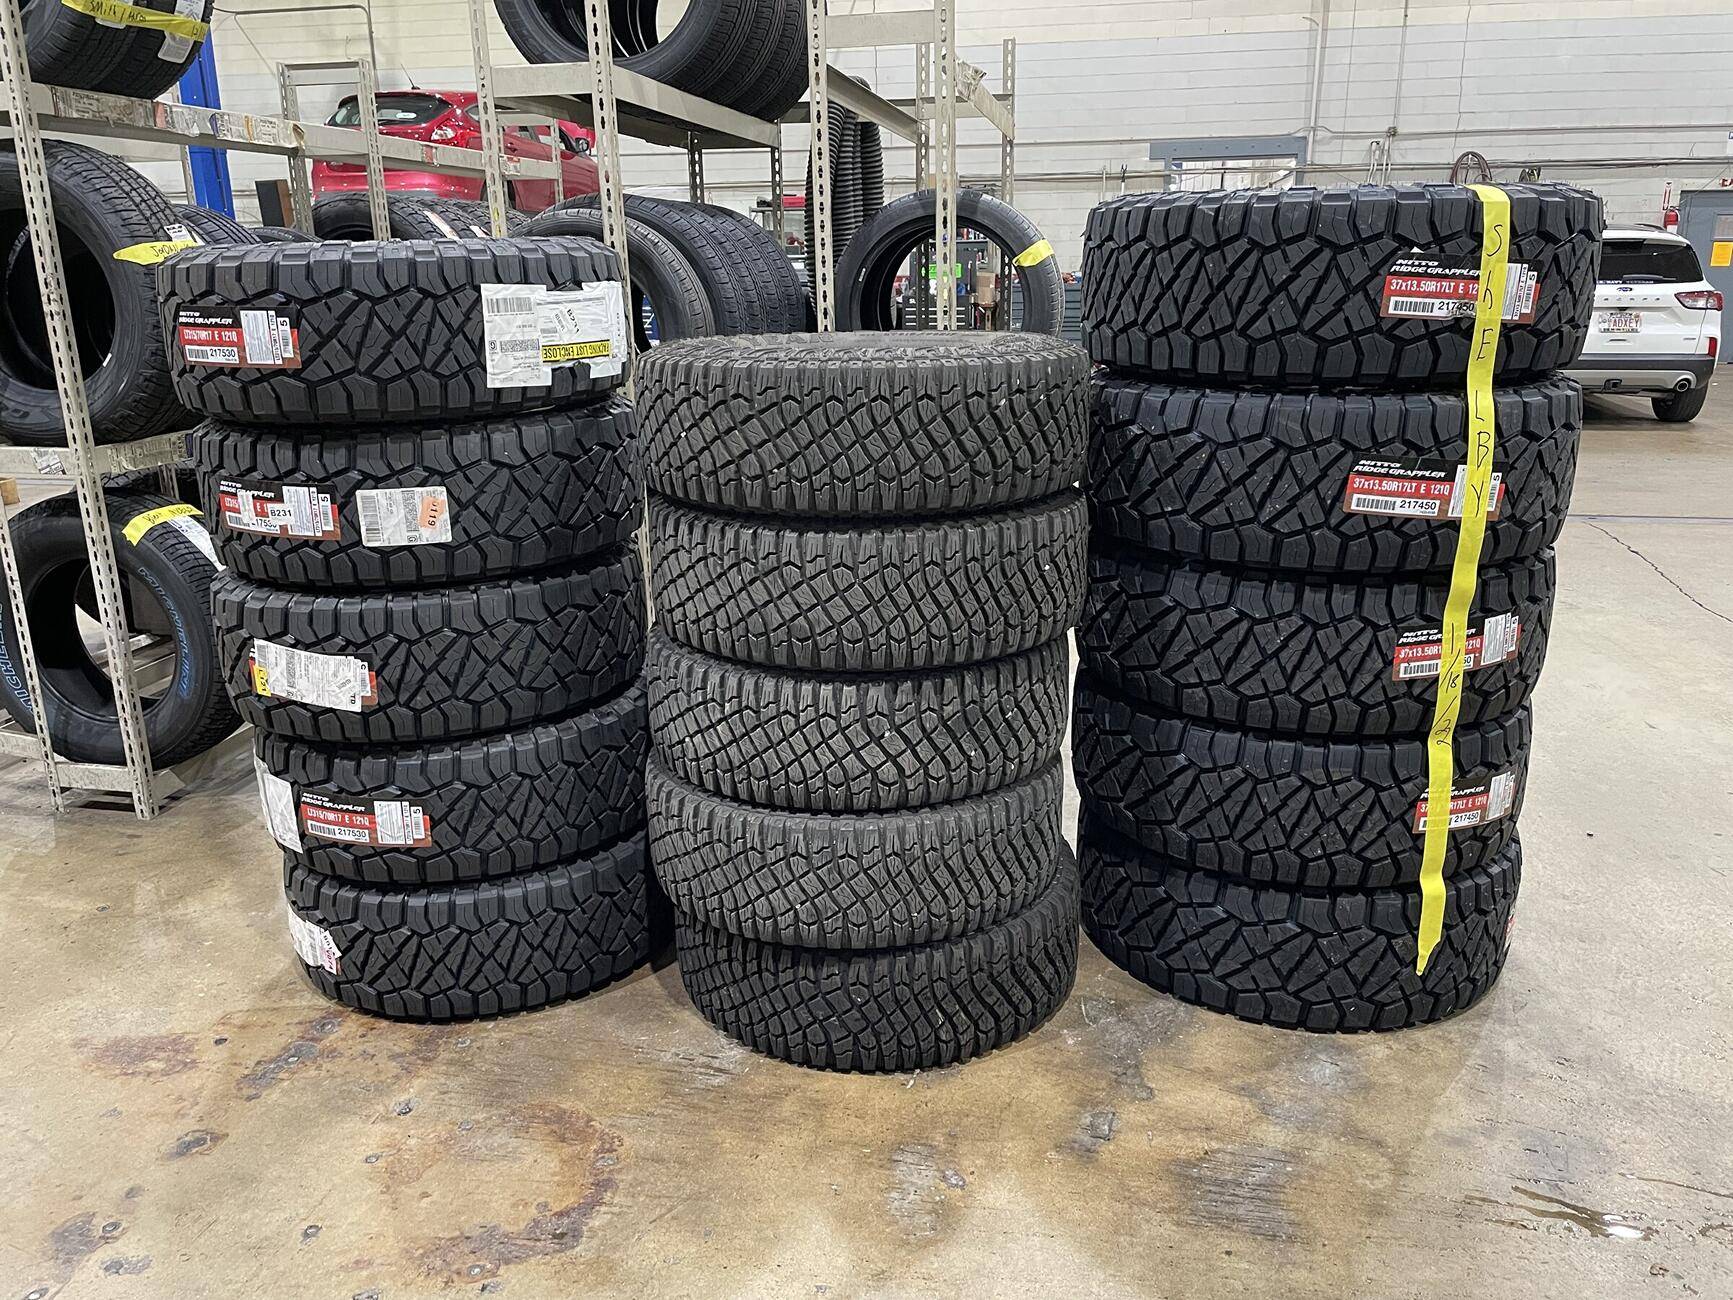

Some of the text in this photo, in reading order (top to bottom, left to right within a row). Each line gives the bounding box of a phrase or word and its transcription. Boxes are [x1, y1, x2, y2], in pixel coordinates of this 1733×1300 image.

[1390, 265, 1425, 274] RIDGE
[1390, 279, 1478, 295] 37x13.50R17LT E 12
[1437, 302, 1474, 312] 217450
[279, 319, 288, 327] 5
[214, 330, 219, 341] E
[209, 348, 236, 358] 217530
[1358, 459, 1402, 468] NITTO
[1353, 465, 1446, 479] RIDGE GRAPPLER
[1353, 478, 1450, 495] 37x13.50R17LT E 121Q
[1399, 500, 1437, 511] 217450
[270, 509, 292, 517] B231
[1402, 629, 1439, 637] NITTO
[1398, 645, 1442, 659] 37x13.50R1
[302, 792, 329, 801] NITTO
[1468, 799, 1473, 807] E
[345, 815, 350, 823] E
[352, 816, 370, 826] 121Q
[1454, 812, 1479, 823] 217450
[337, 828, 367, 838] 217530
